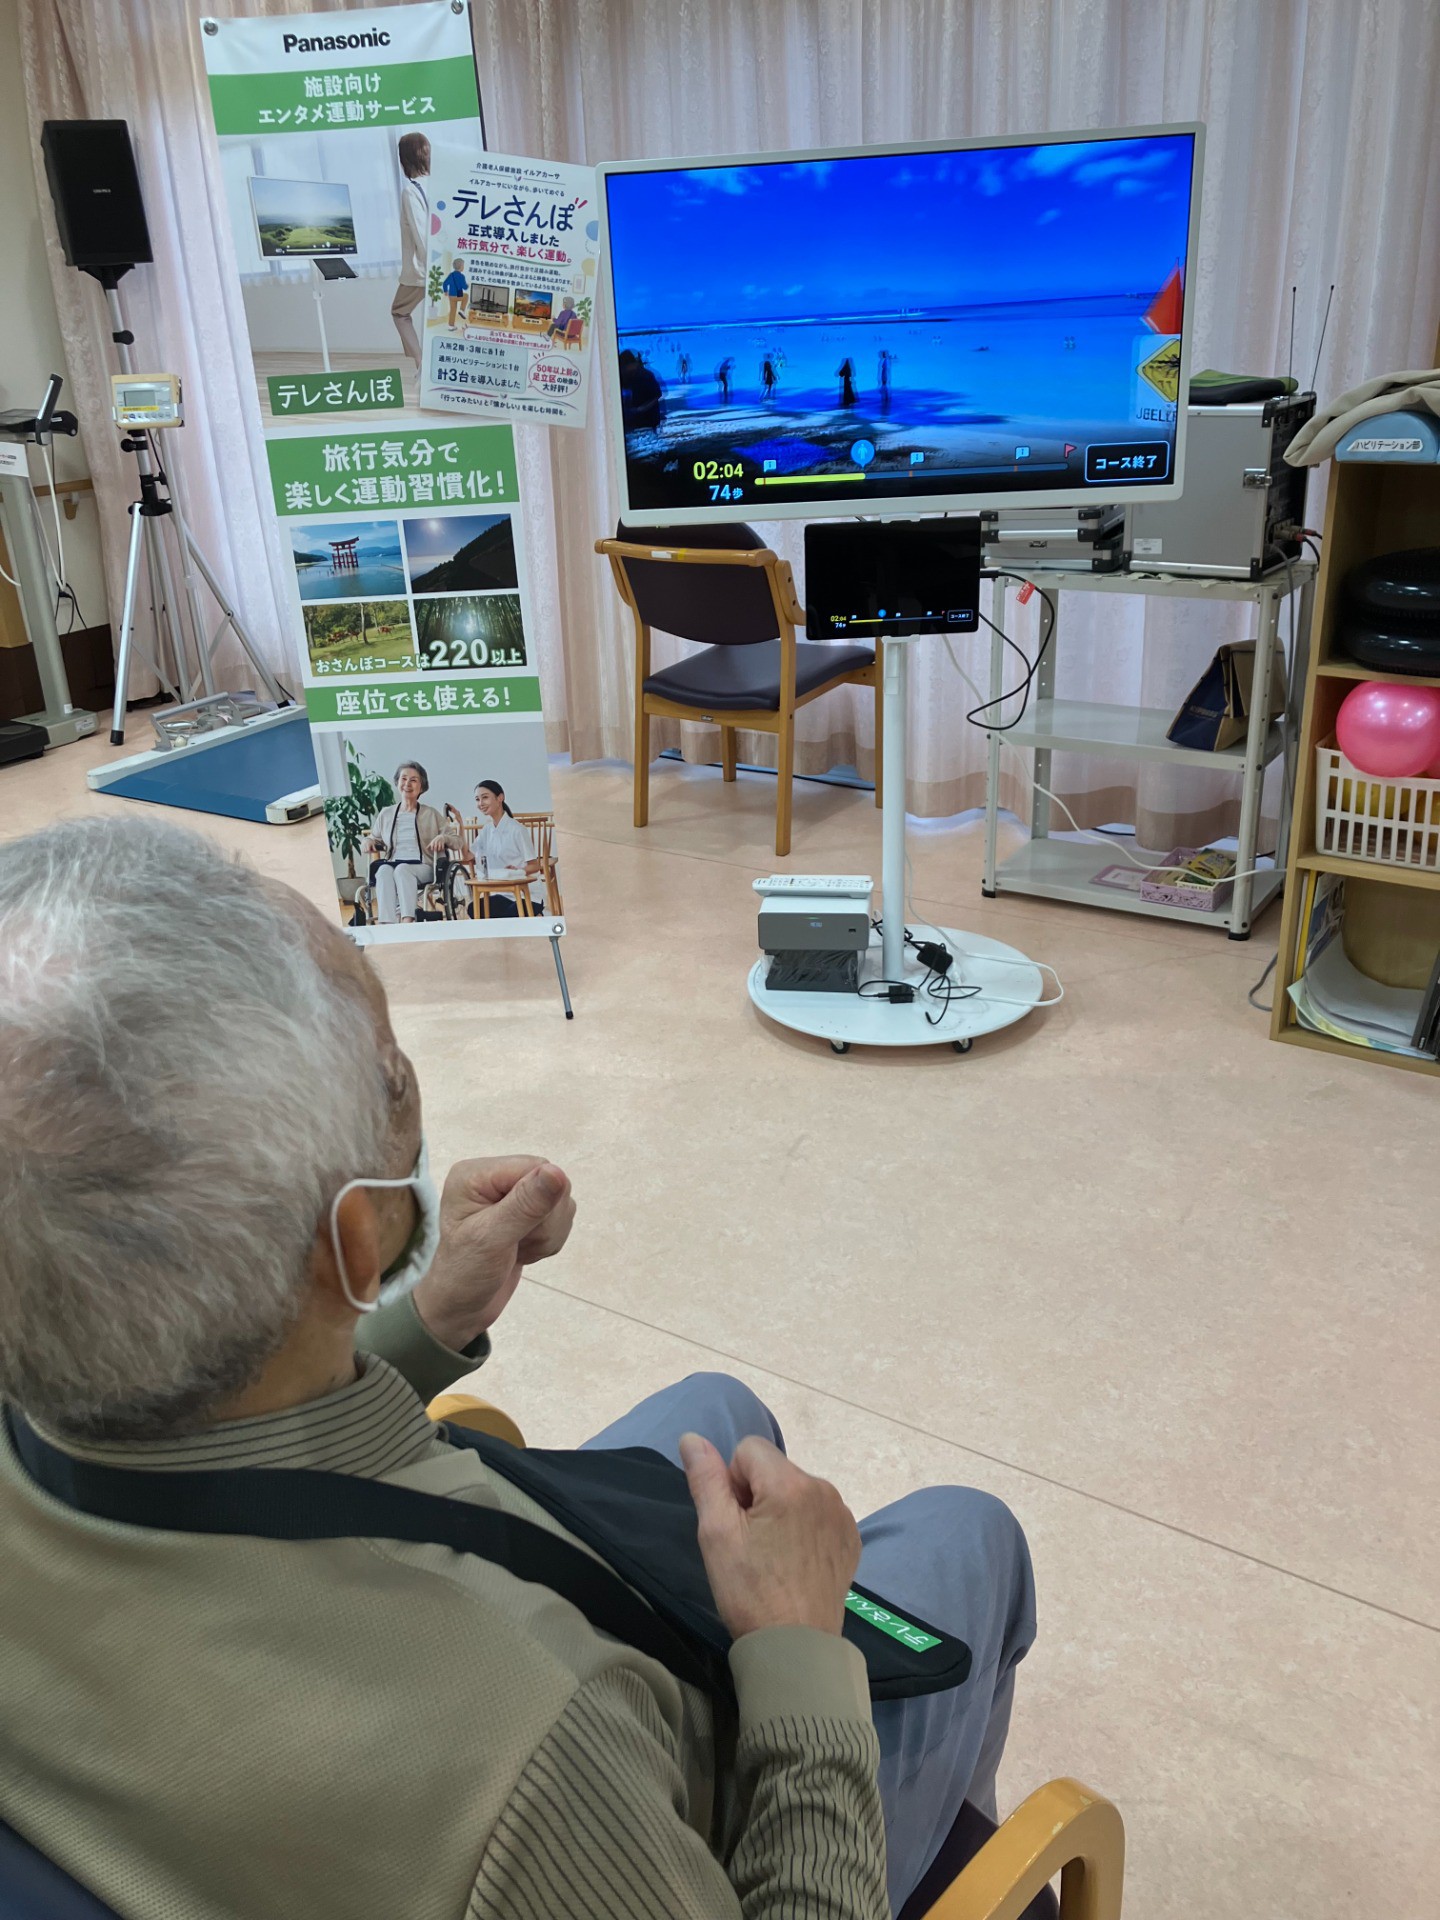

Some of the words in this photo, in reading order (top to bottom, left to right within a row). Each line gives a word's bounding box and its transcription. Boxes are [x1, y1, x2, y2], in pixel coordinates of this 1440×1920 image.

[283, 27, 391, 53] Panasonic
[303, 73, 382, 98] 施設向け
[258, 96, 436, 125] エンタメ運動サービス
[523, 169, 561, 180] イルアカーサ
[452, 189, 576, 232] テレさんぽ
[467, 223, 560, 247] 正式導入しました
[456, 237, 572, 264] 旅行気分で、楽しく運動。
[437, 367, 521, 390] 計3台を導入しました
[277, 375, 395, 409] テレさんぽ
[322, 438, 460, 472] 旅行気分で
[1352, 440, 1421, 450] ハビリテーション部
[693, 461, 744, 480] 02:04
[1095, 455, 1158, 470] コース終了
[284, 469, 506, 510] 楽しく運動習慣化!
[708, 484, 744, 501] 74歩
[335, 684, 511, 716] 座位でも使える!
